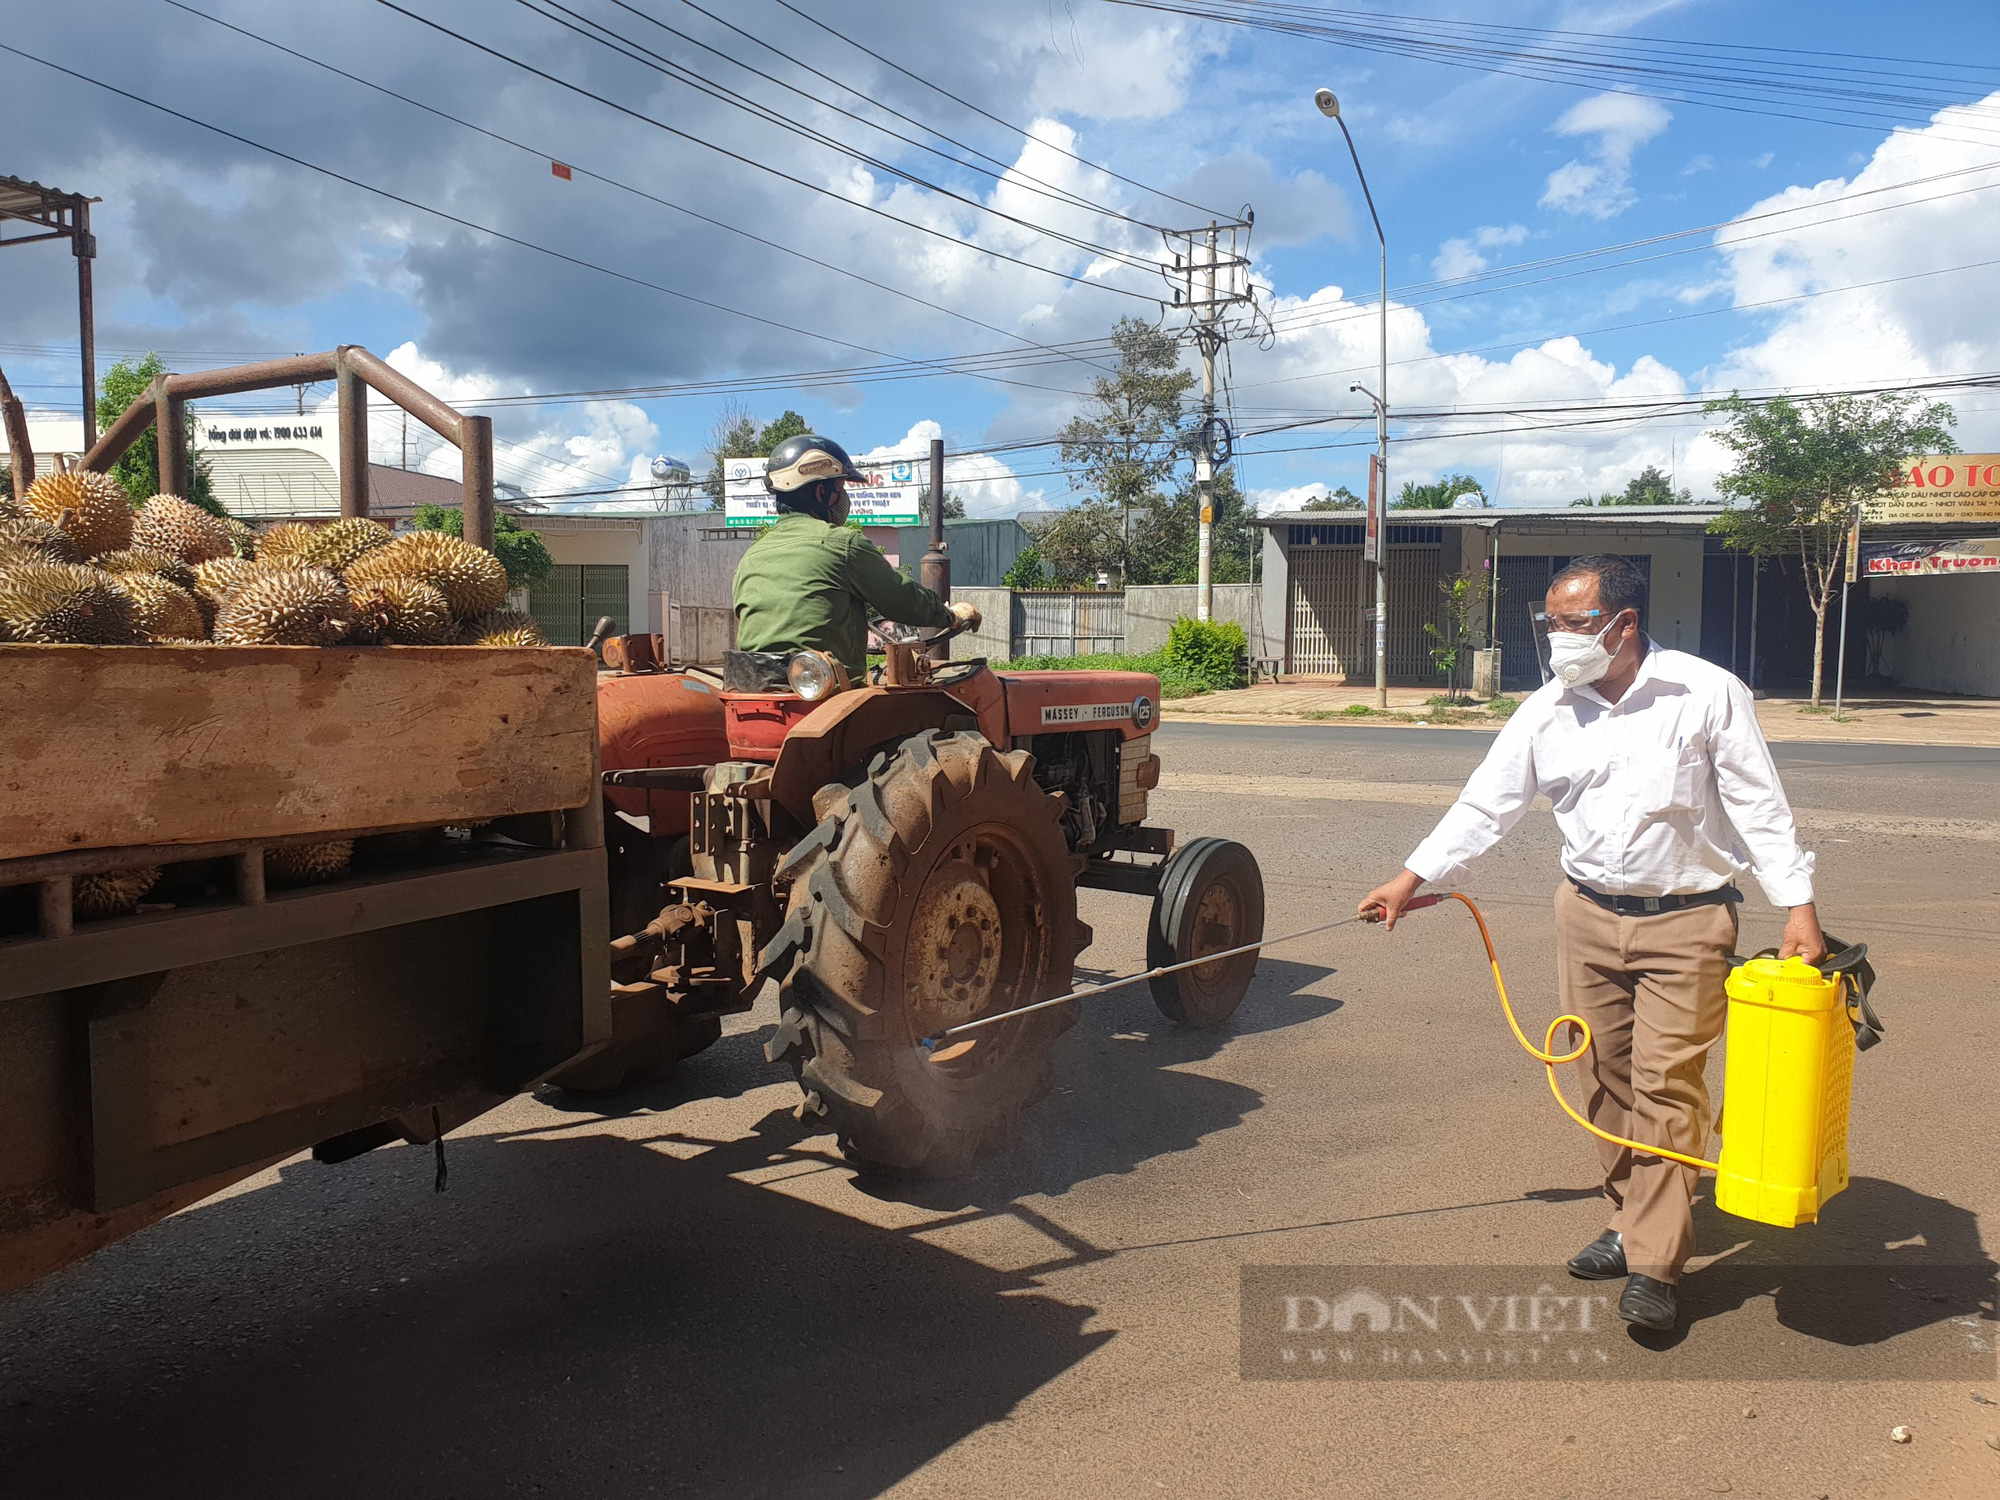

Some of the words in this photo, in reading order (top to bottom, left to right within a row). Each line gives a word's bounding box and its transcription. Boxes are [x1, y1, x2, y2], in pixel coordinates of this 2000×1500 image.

[274, 426, 291, 440] 1900
[1869, 557, 1921, 571] Khai
[1045, 708, 1079, 721] MASSEY
[1093, 705, 1130, 719] FERGUSON
